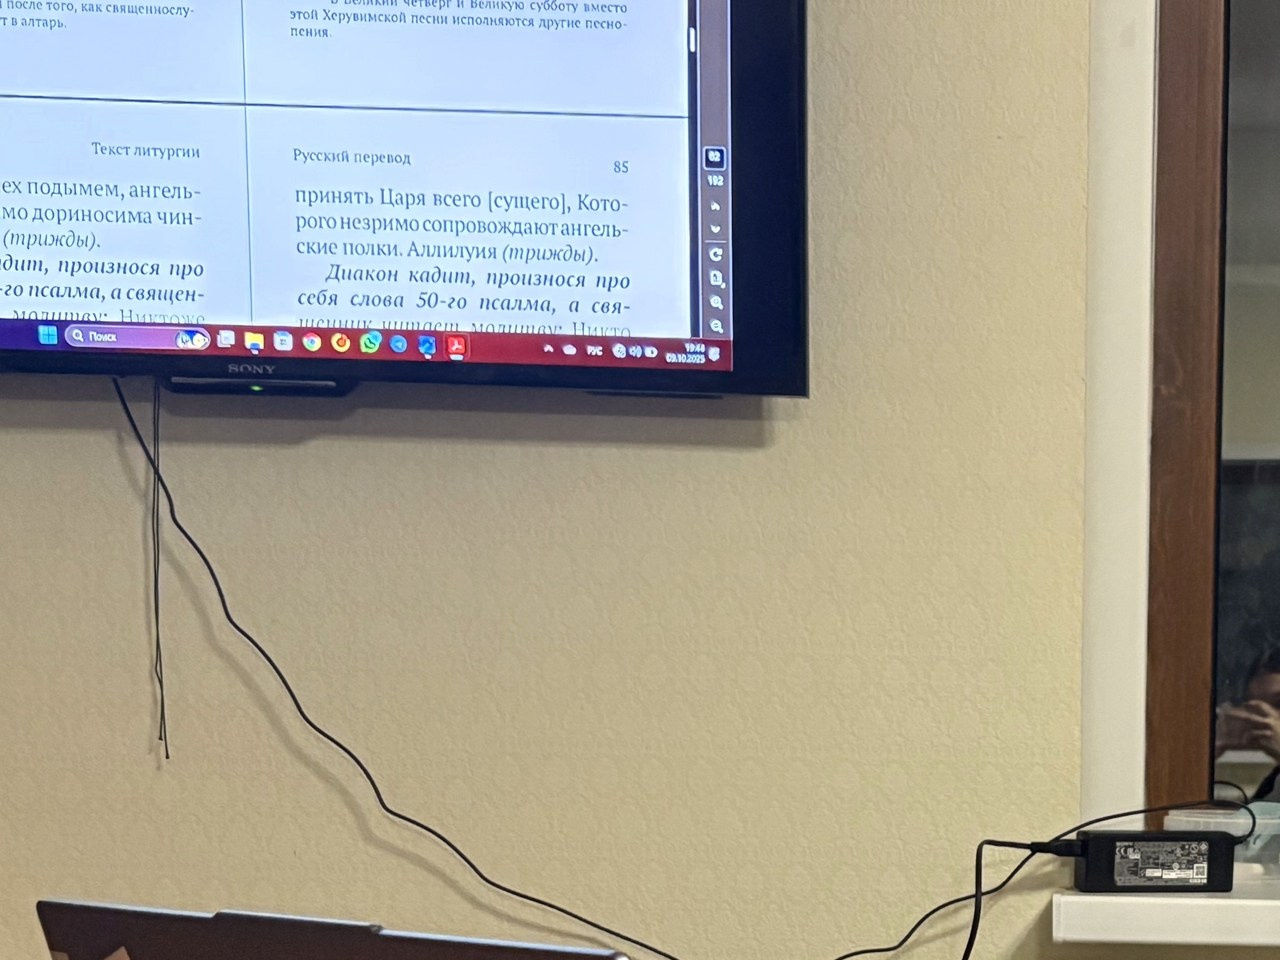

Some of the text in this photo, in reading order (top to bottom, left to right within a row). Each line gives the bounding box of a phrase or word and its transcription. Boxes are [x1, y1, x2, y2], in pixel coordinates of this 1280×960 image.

[7, 1, 195, 17] после того, как священнослу-
[530, 1, 578, 13] субботу
[584, 3, 628, 13] вместо
[21, 18, 67, 30] алтарь.
[290, 9, 628, 30] этой Херувимской песни исполняются другие песно-
[290, 27, 332, 38] пения.
[92, 142, 201, 160] Текст литургии
[293, 148, 411, 166] Русский перевод
[613, 160, 629, 174] 85
[27, 181, 126, 200] подымем,
[129, 184, 202, 199] ангель-
[295, 188, 629, 215] принять Царя всего [сущего], Кото-
[32, 206, 153, 226] дориносима
[157, 210, 202, 226] чин-
[296, 215, 629, 238] рого незримо сопровождают ангель-
[3, 229, 101, 251] (трижды).
[296, 240, 599, 266] ские полки. Аллилуия (трижды).
[0, 253, 204, 280] дит, произнося про
[325, 263, 630, 292] Диакон кадит, произнося про
[29, 284, 106, 303] псалма,
[110, 286, 122, 300] а
[126, 287, 205, 305] священ-
[298, 289, 631, 315] себя слова 50-го псалма, а свя-
[89, 331, 118, 342] Поиск
[228, 363, 276, 375] SONY
